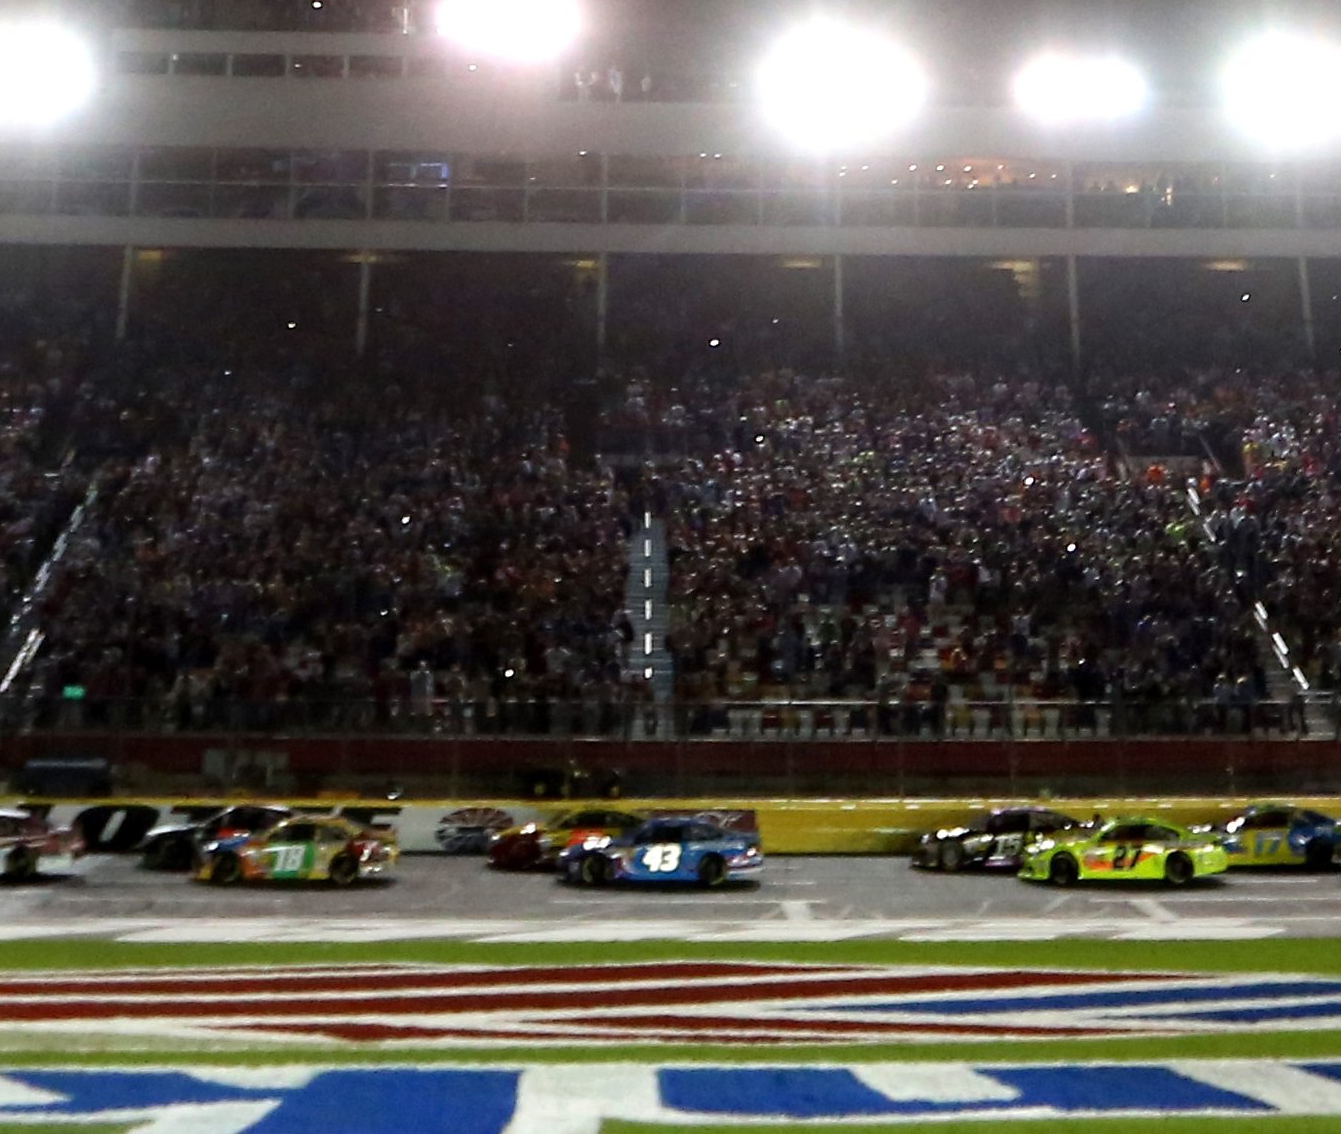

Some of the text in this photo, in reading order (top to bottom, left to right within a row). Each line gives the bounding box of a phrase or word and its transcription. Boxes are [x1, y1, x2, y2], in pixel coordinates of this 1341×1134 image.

[275, 846, 304, 871] 18
[643, 844, 681, 872] 43
[1112, 843, 1143, 871] 27
